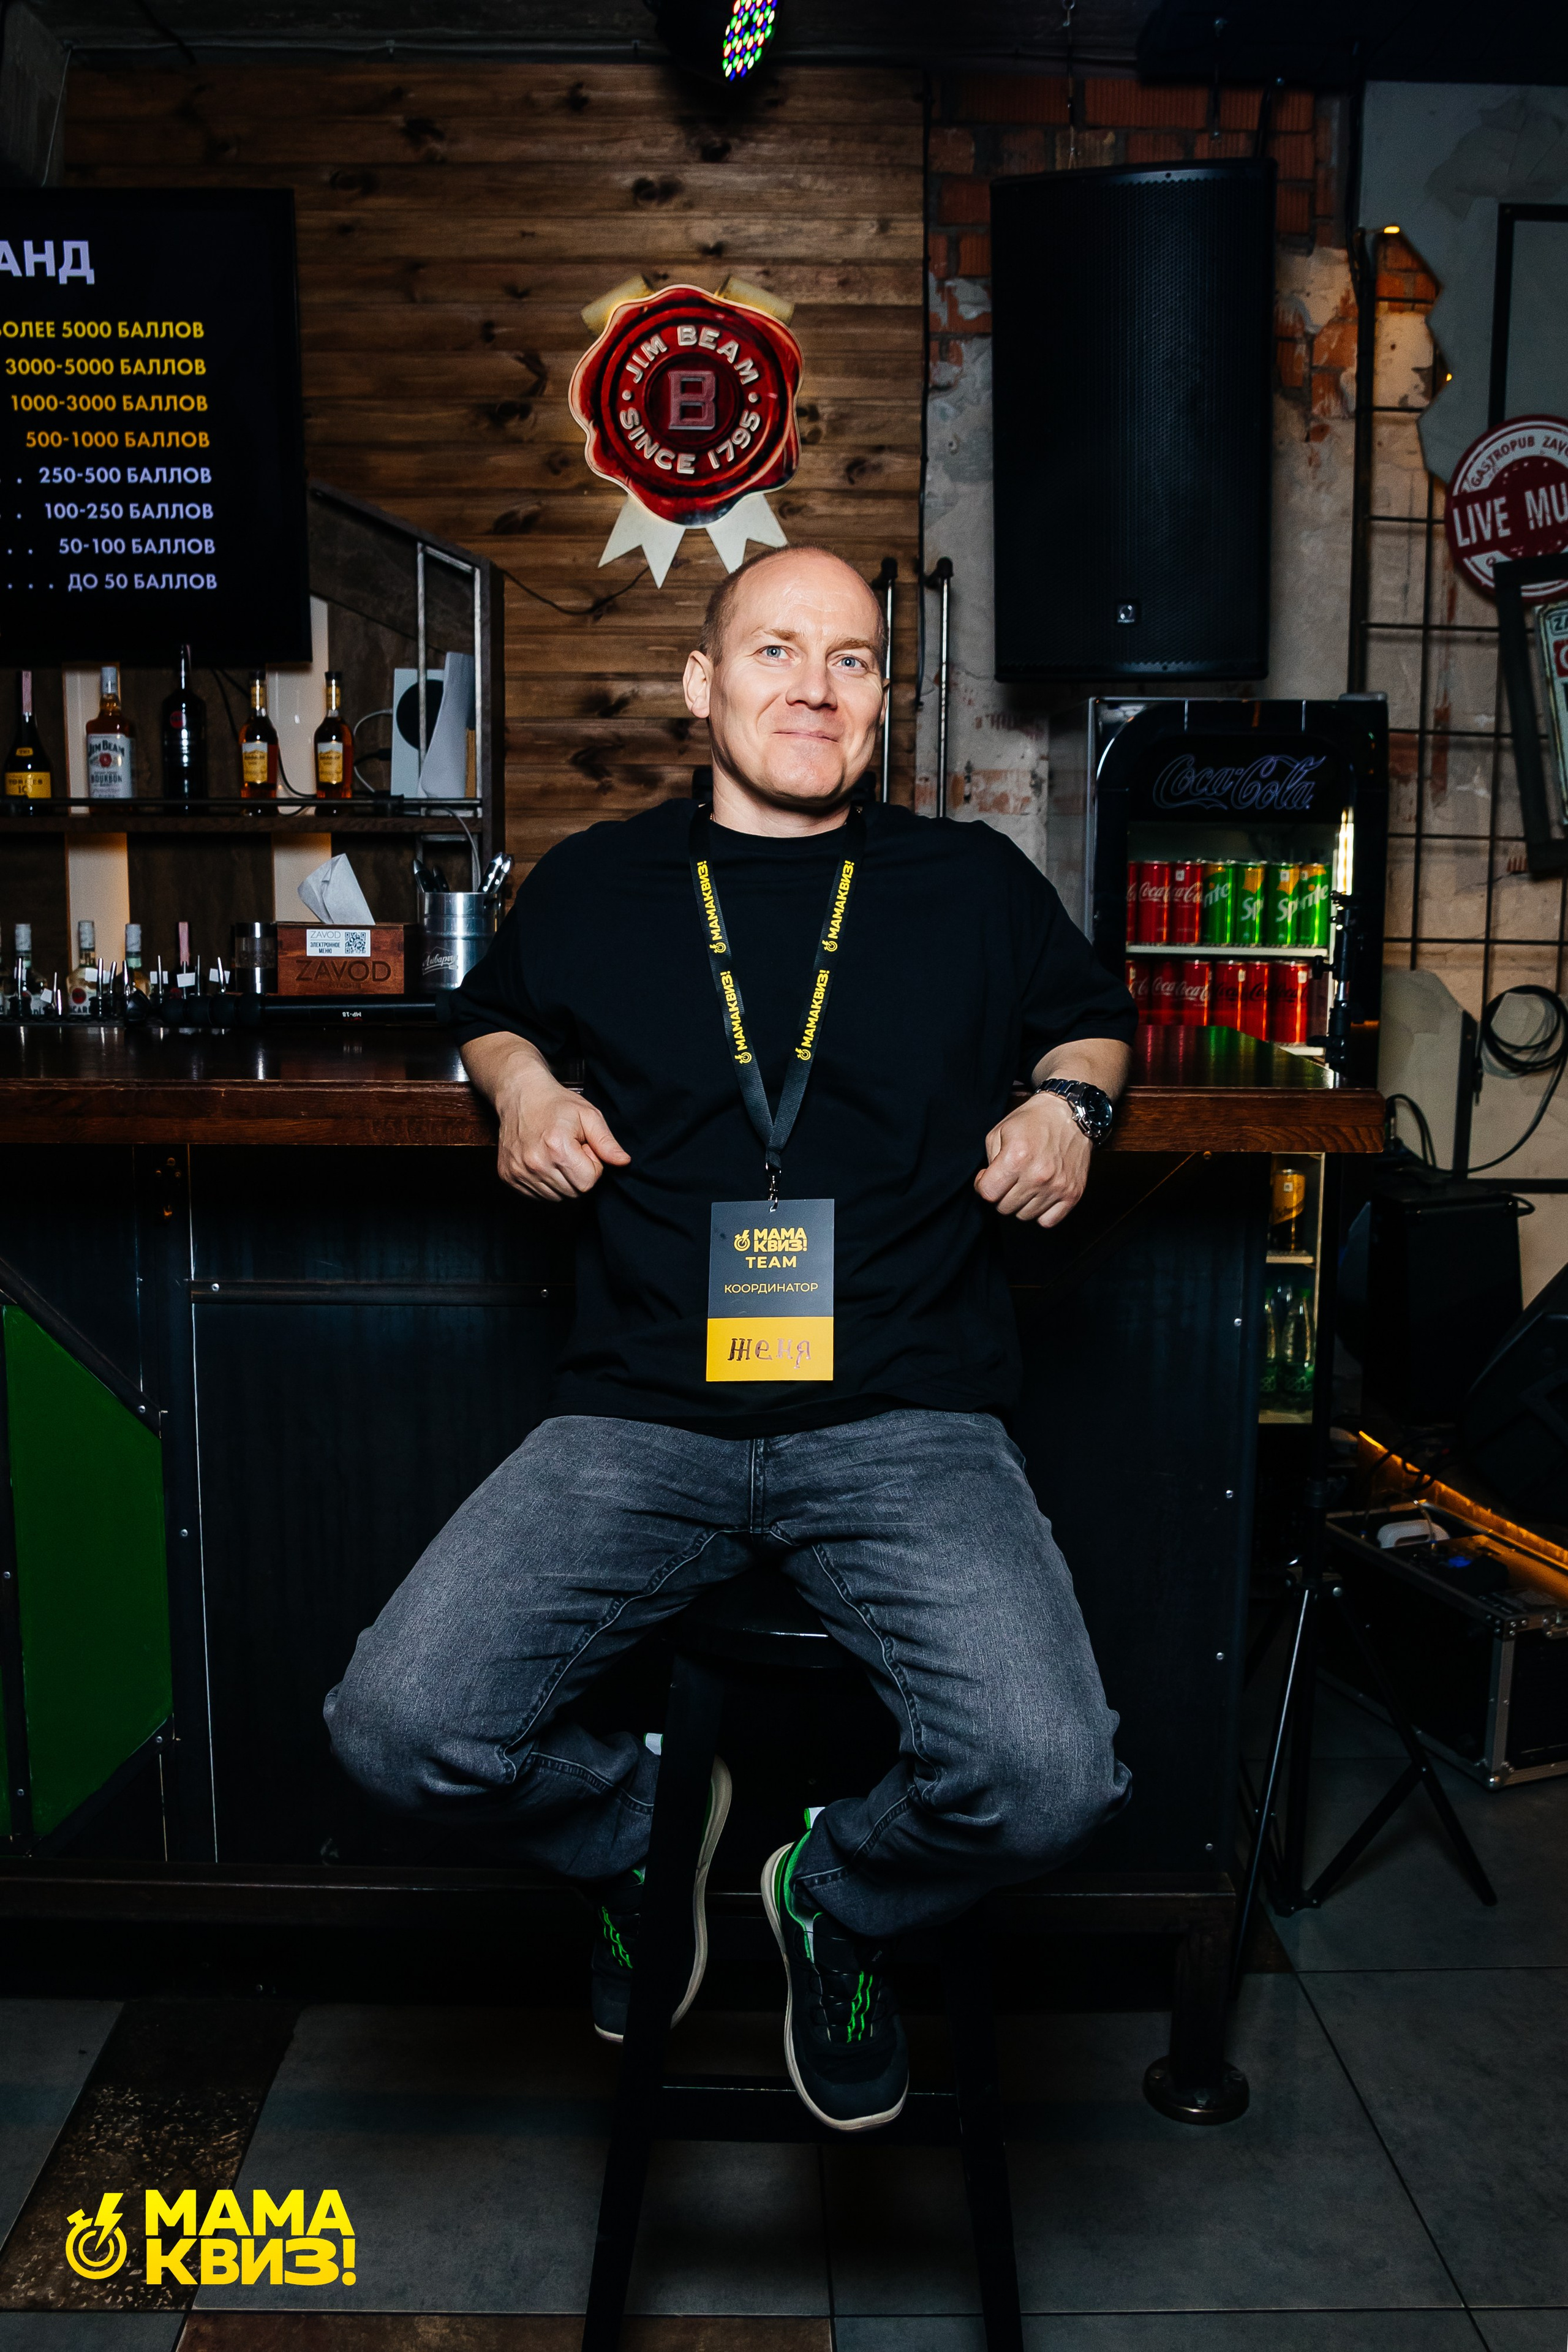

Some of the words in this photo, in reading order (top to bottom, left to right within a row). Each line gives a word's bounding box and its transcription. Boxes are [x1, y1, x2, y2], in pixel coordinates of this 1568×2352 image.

[0, 321, 55, 338] ОЛЕЕ
[62, 321, 112, 338] 5000
[118, 321, 205, 338] БАЛЛОВ
[625, 333, 668, 384] JIM
[677, 324, 759, 385] BEAM
[6, 358, 114, 375] 3000-5000
[120, 358, 206, 375] БАЛЛОВ
[11, 394, 116, 411] 1000-3000
[123, 394, 208, 412] БАЛЛОВ
[668, 370, 716, 430] B
[26, 431, 119, 448] 500-1000
[124, 431, 210, 448] БАЛЛОВ
[619, 407, 696, 474] SINCE
[707, 410, 760, 469] 1795
[1471, 435, 1535, 488] GASTROPUB
[39, 466, 121, 484] 250-500
[127, 467, 212, 484] БАЛЛОВ
[45, 502, 124, 519] 100-250
[129, 502, 214, 519] БАЛЛОВ
[1452, 496, 1512, 548] LIVE
[59, 538, 126, 554] 50-100
[131, 538, 216, 554] БАЛЛОВ
[67, 573, 99, 592] ДО
[105, 573, 128, 589] 50
[134, 573, 217, 589] БАЛЛОВ
[1152, 753, 1327, 811] Coca-Cola
[696, 860, 723, 941] МАМАКВИЗ!
[827, 859, 854, 940] МАМАКВИЗ!
[310, 930, 341, 939] ZAVOD
[296, 959, 392, 982] ZAVOD
[720, 970, 748, 1051] МАМАКВИЗ!
[801, 969, 830, 1048] МАМАКВИЗ!
[753, 1227, 807, 1240] МАМА
[753, 1239, 807, 1253] КВИЗ!
[745, 1256, 797, 1268] TEAM
[724, 1283, 818, 1294] КООРДИНАТОР
